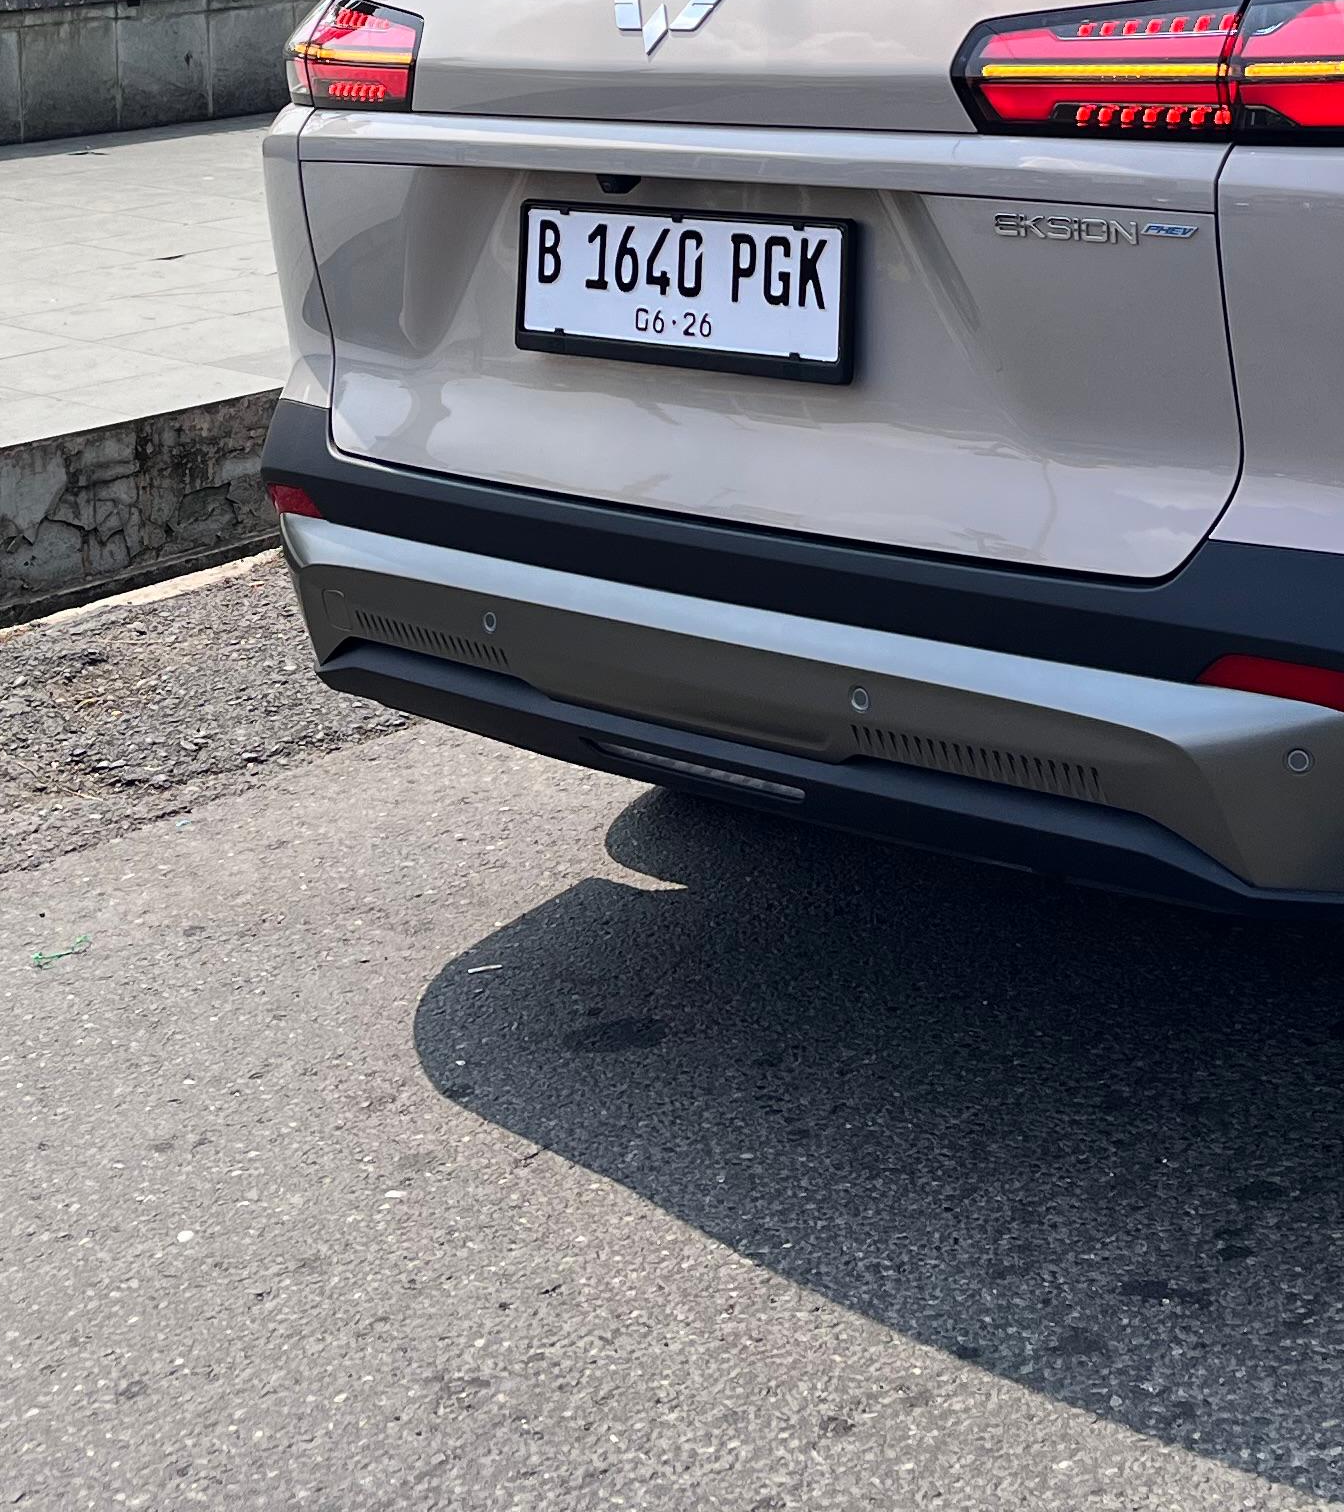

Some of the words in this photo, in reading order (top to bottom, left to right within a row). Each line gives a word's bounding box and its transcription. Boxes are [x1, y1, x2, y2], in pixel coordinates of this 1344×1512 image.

[994, 212, 1138, 245] EKSION
[1145, 224, 1194, 238] PHEV
[537, 219, 562, 284] B
[584, 223, 704, 298] 1640
[730, 232, 828, 310] PGK
